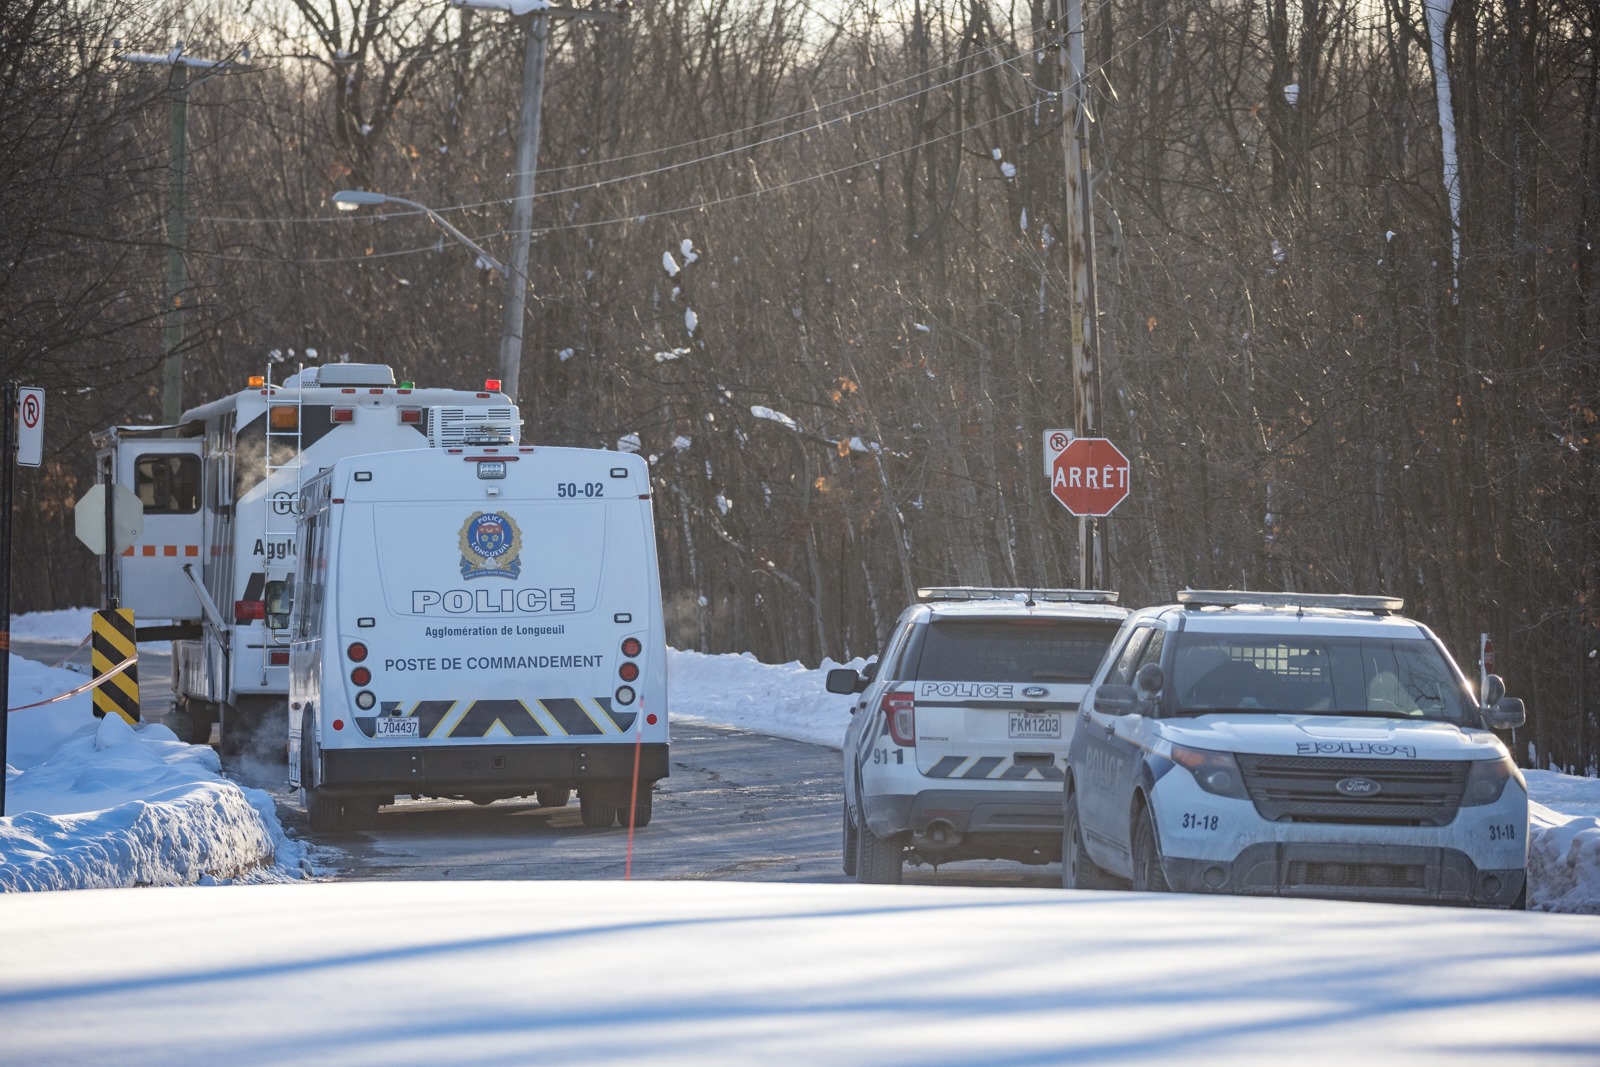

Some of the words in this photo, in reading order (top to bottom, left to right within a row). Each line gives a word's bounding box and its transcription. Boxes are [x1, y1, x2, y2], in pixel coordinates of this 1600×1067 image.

[1054, 464, 1127, 489] ARRÊT
[557, 482, 604, 498] 50-02
[477, 515, 503, 524] POLICE
[471, 542, 510, 557] LONGUEUIL
[412, 588, 576, 614] POLICE
[425, 626, 498, 639] Agglomération
[501, 625, 513, 636] de
[516, 625, 565, 637] Longueuil
[385, 658, 436, 672] POSTE
[441, 657, 462, 670] DE
[466, 655, 603, 670] COMMANDEMENT
[921, 683, 1013, 698] POLICE
[1026, 688, 1044, 696] Ford
[377, 722, 417, 733] L704437
[1011, 718, 1058, 732] FKM1203
[1086, 745, 1125, 787] POLICE
[1346, 781, 1371, 792] Ford
[1182, 813, 1218, 831] 31-18
[1489, 824, 1514, 840] 31-18
